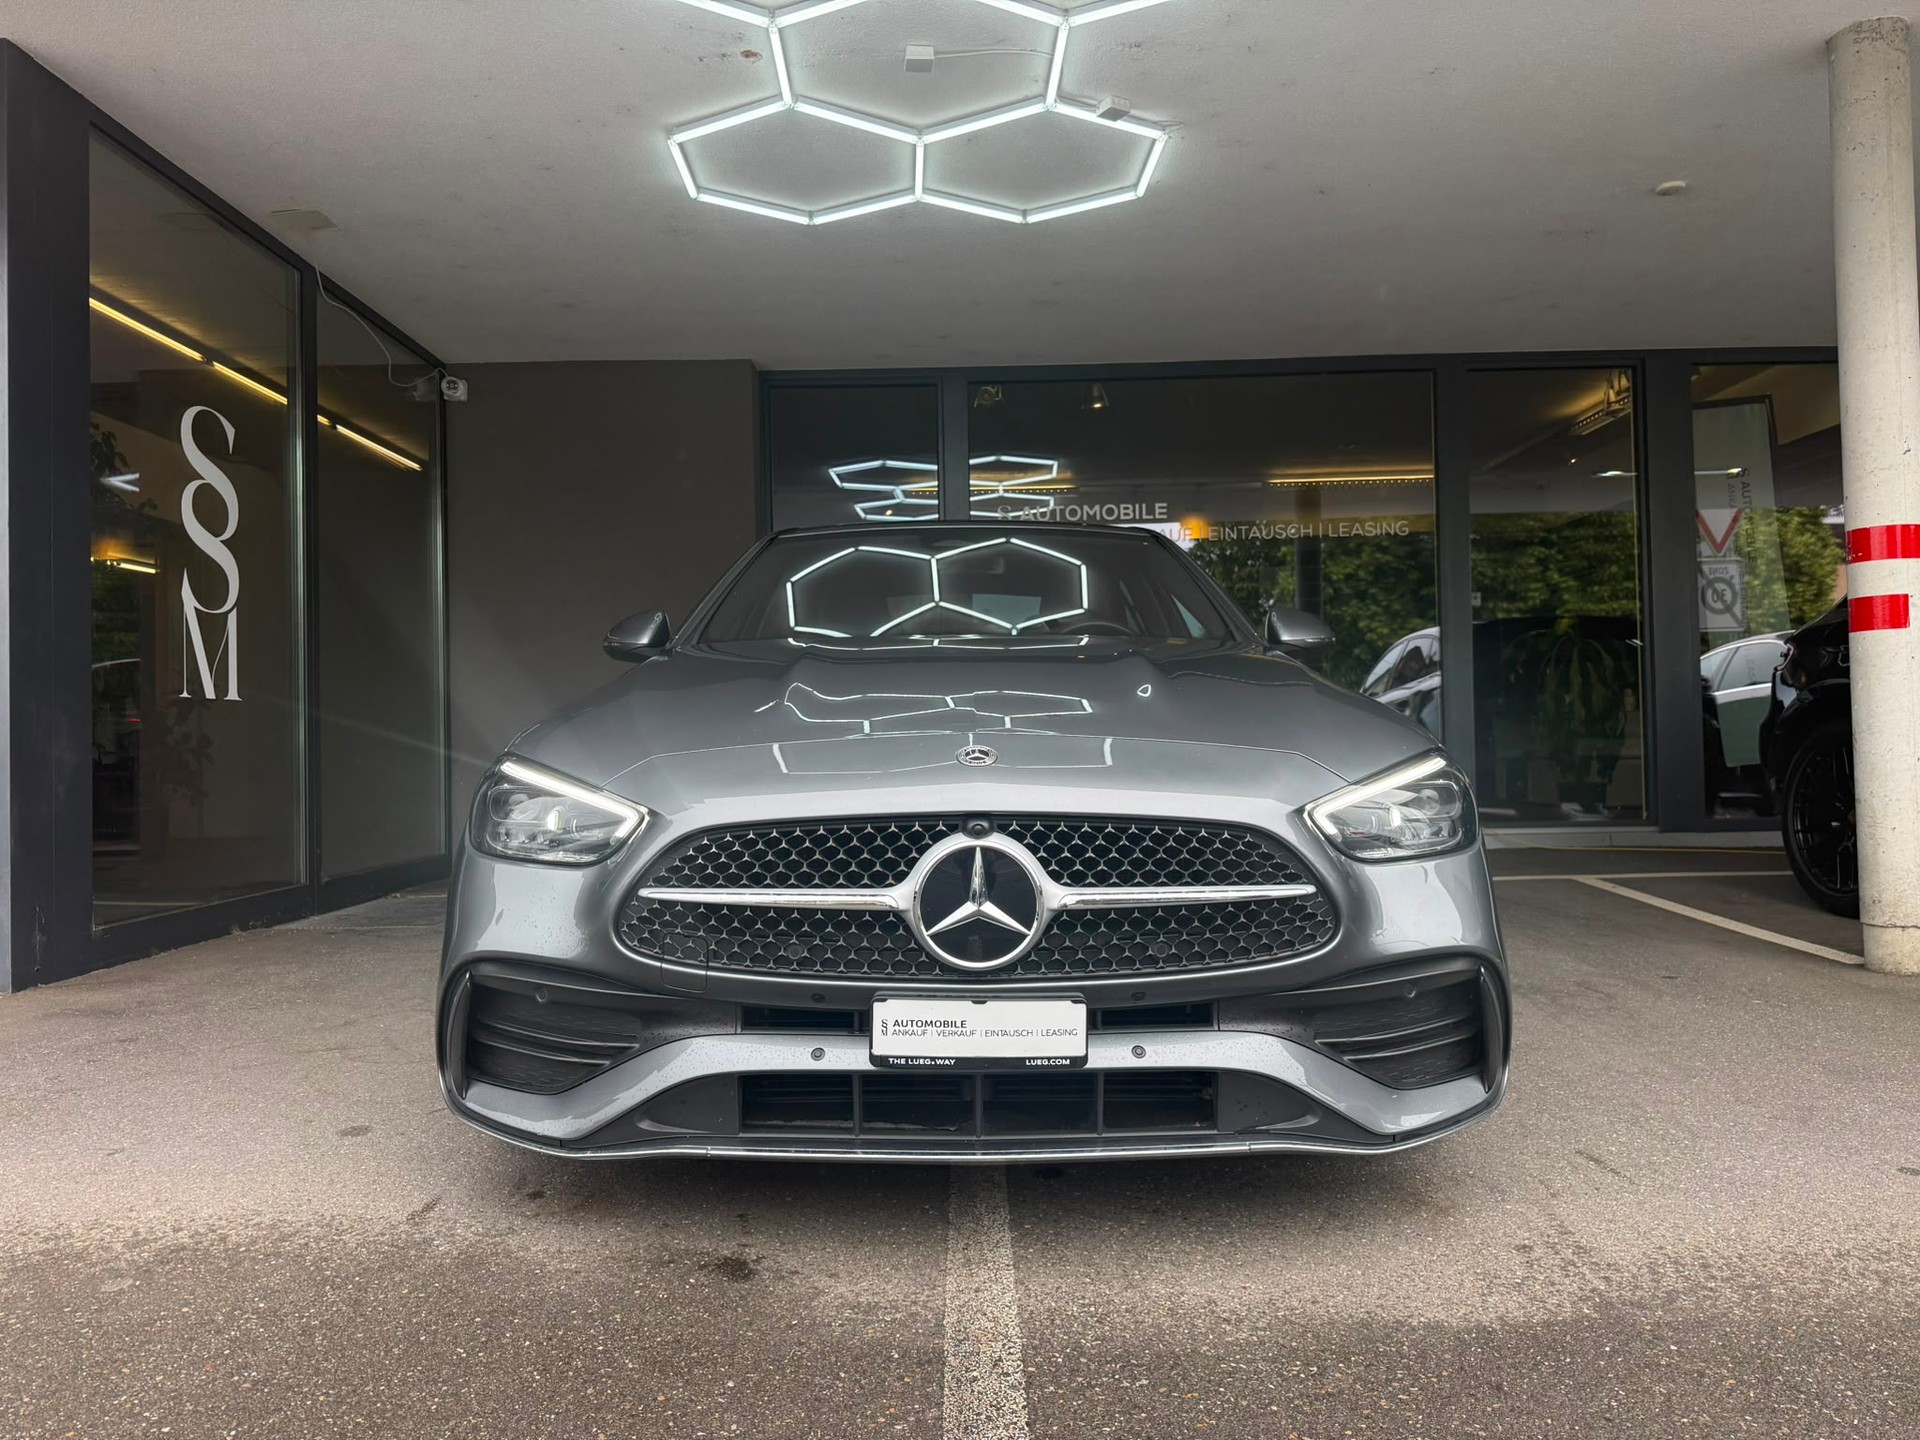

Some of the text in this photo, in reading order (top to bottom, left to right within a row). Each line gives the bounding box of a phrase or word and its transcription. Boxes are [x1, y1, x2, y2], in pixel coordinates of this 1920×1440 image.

[1020, 503, 1168, 521] AUTOMOBILE
[1328, 520, 1409, 537] LEASING
[893, 1019, 967, 1029] AUTOMOBILE
[892, 1029, 928, 1037] ANKAUF
[936, 1029, 977, 1037] VERKAUF
[985, 1029, 1033, 1037] EINTAUSCH
[1041, 1028, 1078, 1037] LEASING
